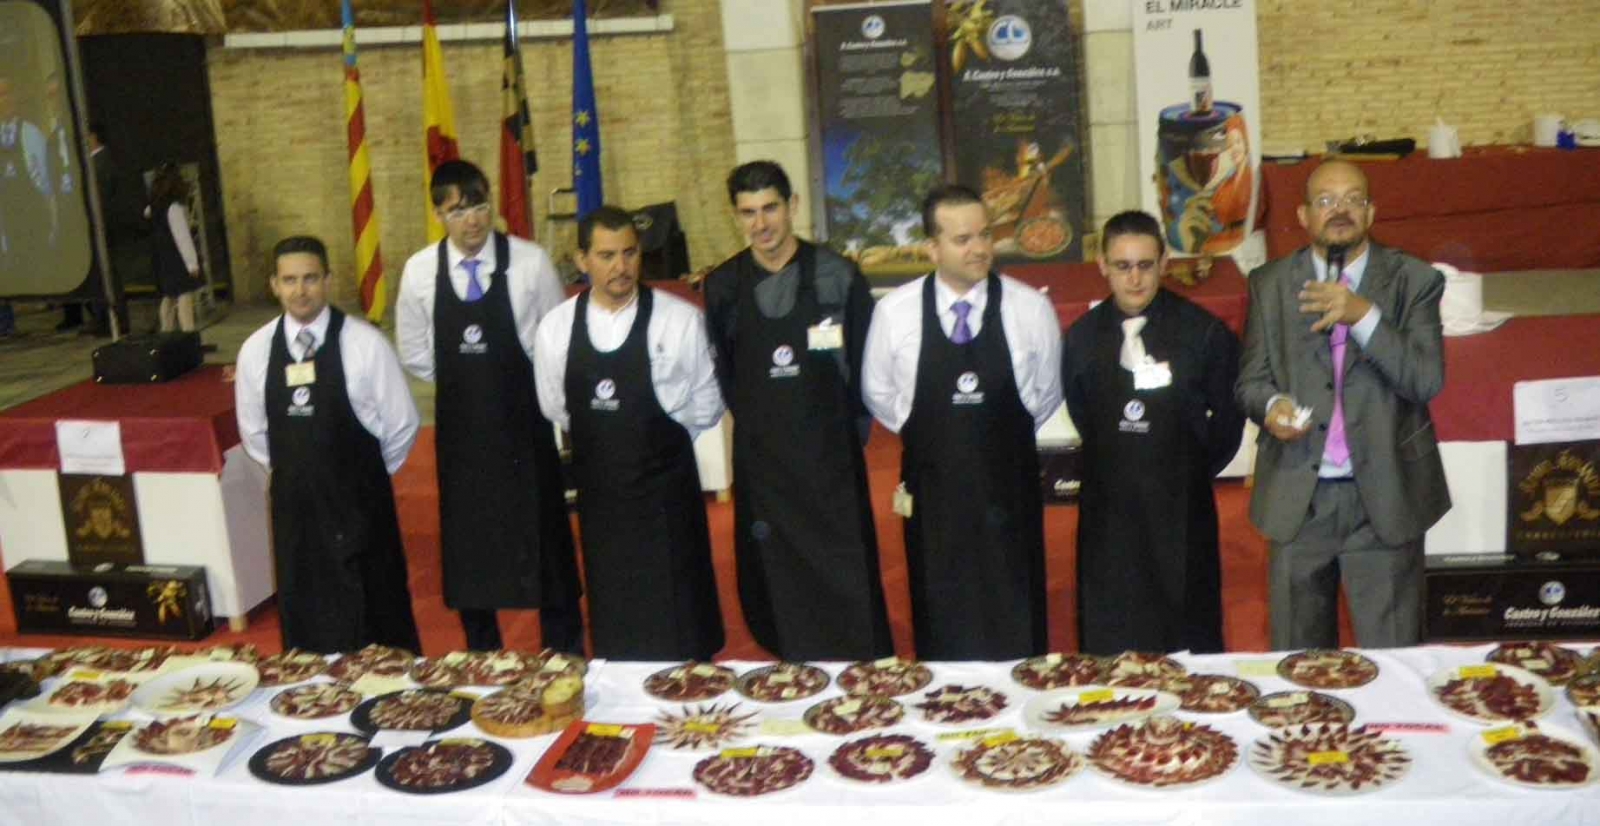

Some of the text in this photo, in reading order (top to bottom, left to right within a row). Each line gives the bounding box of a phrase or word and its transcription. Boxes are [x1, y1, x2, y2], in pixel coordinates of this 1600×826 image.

[1146, 0, 1166, 13] EL
[1147, 19, 1173, 31] ART
[1503, 606, 1541, 620] Castro
